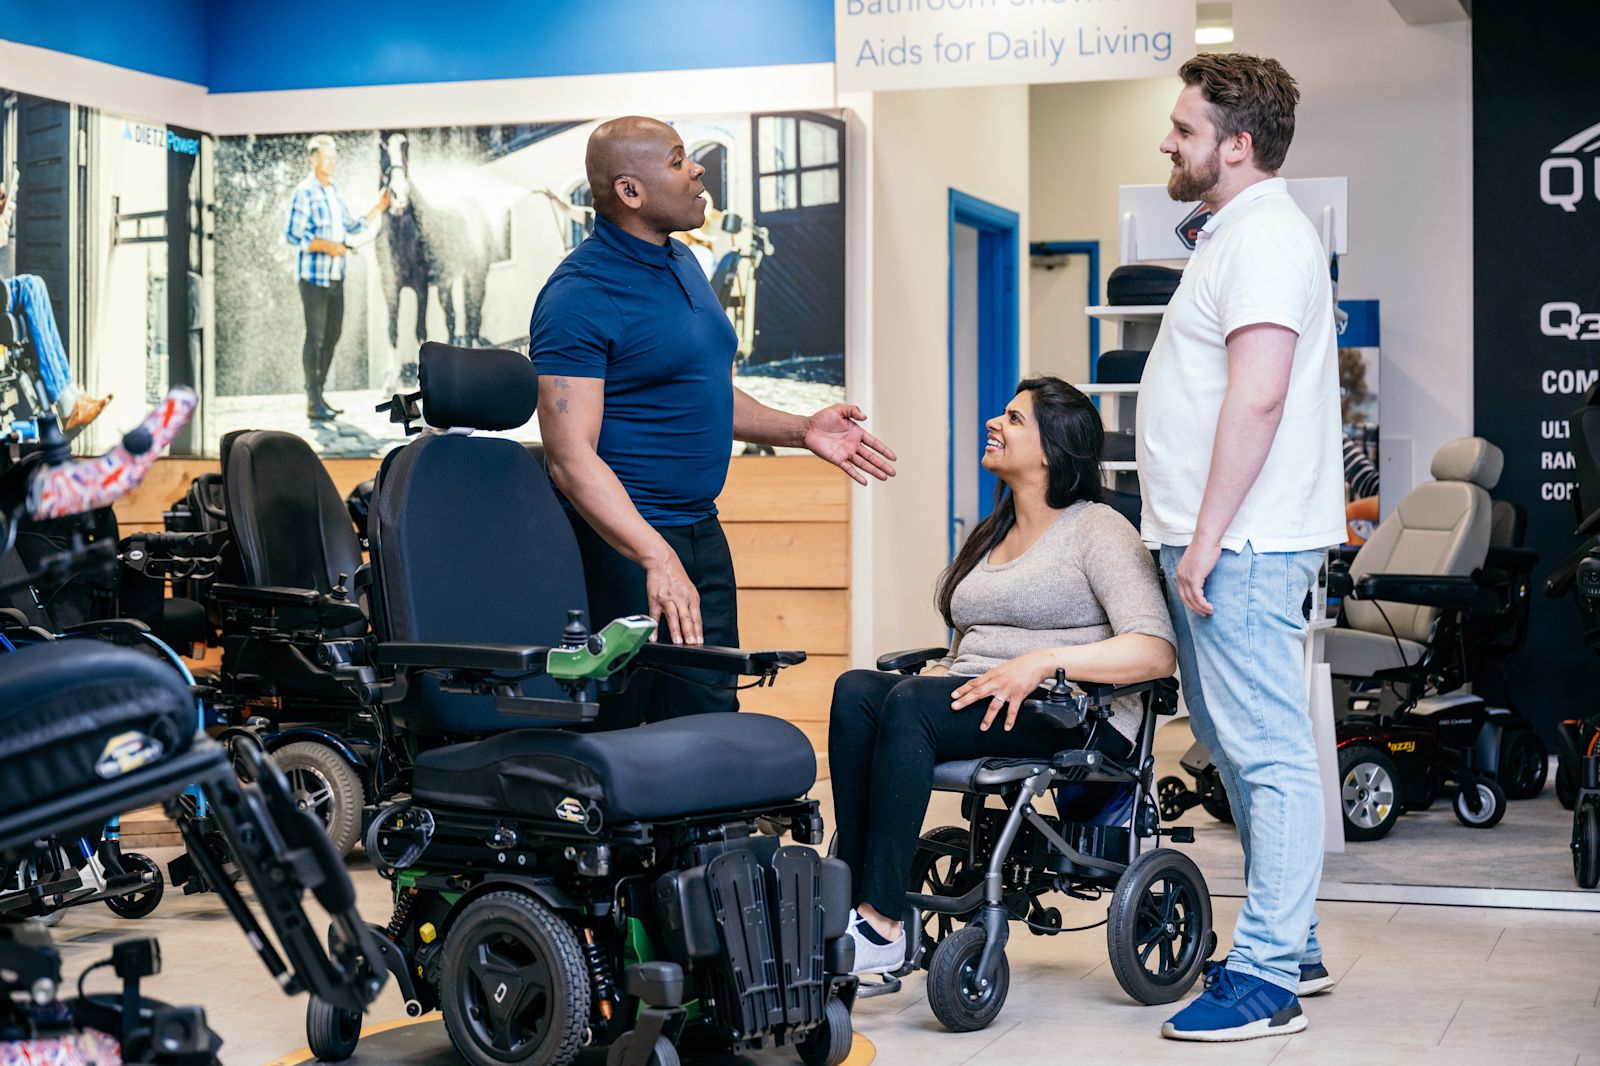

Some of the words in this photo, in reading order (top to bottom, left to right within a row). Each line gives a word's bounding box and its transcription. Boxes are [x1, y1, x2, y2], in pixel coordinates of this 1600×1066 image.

[856, 35, 923, 67] Aids
[934, 32, 976, 63] for
[987, 28, 1066, 66] Daily
[1078, 25, 1172, 61] Living
[135, 125, 164, 147] DIETZ
[167, 130, 198, 155] Power
[1539, 156, 1600, 212] Q
